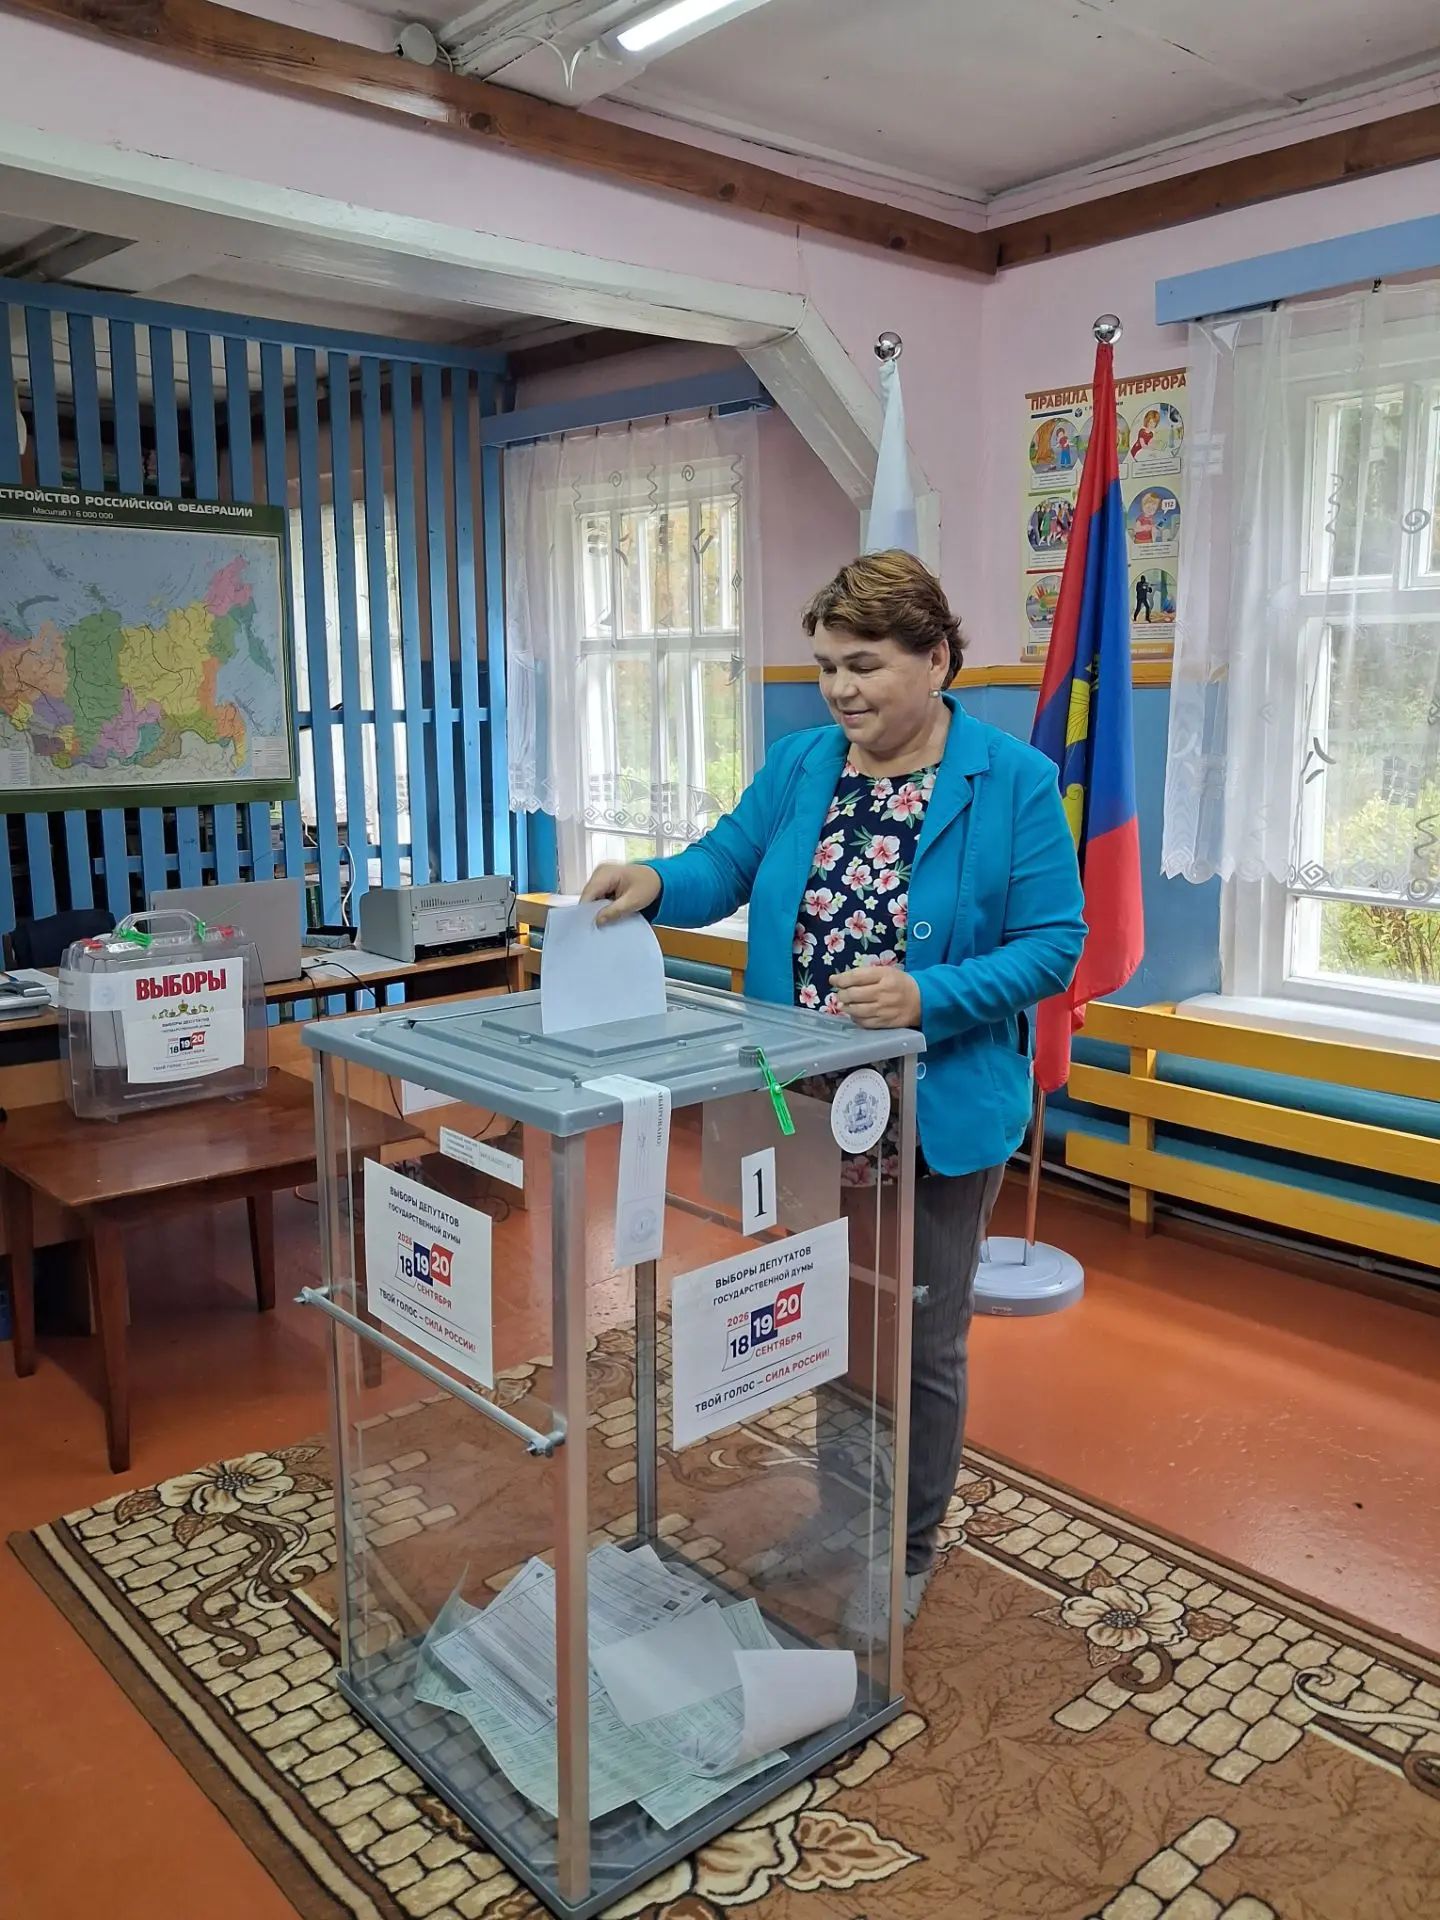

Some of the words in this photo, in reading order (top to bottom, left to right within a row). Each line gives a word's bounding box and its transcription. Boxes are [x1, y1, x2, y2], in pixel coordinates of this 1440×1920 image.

[1031, 390, 1088, 410] ПРАВИЛА
[1114, 374, 1187, 397] ИТЕРРОРА
[85, 496, 173, 511] РОССИЙСКОЙ
[178, 503, 253, 517] ФЕДЕРАЦИИ
[136, 968, 226, 1000] ВЫБОРЫ
[169, 1046, 179, 1054] 18
[180, 1040, 190, 1049] 19
[192, 1035, 204, 1043] 20
[389, 1186, 418, 1207] ВЫБОРЫ
[419, 1201, 459, 1227] ДЕПУТАТОВ
[752, 1168, 767, 1218] 1
[388, 1203, 441, 1236] ГОСУДАРСТВЕННОЙ
[442, 1230, 461, 1244] ДУМЫ
[400, 1256, 413, 1277] 18
[415, 1253, 429, 1276] 19
[431, 1251, 449, 1277] 20
[715, 1265, 757, 1288] ВЫБОРЫ
[759, 1246, 811, 1274] ДЕПУТАТОВ
[416, 1283, 452, 1309] СЕНТЯБРЯ
[713, 1269, 790, 1306] ГОСУДАРСТВЕННОЙ
[791, 1263, 814, 1278] ДУМЫ
[379, 1288, 395, 1303] ТВОЙ
[396, 1300, 418, 1318] ГОЛОС
[424, 1316, 443, 1333] СИЛА
[444, 1327, 476, 1353] РОССИИ!
[727, 1311, 749, 1327] 2026
[729, 1335, 749, 1358] 18
[753, 1314, 773, 1338] 19
[776, 1293, 799, 1320] 20
[755, 1332, 802, 1357] СЕНТЯБРЯ
[695, 1393, 722, 1412] ТВОЙ
[724, 1381, 755, 1401] ГОЛОС
[765, 1367, 790, 1383] СИЛА
[792, 1348, 830, 1372] РОССИИ!
